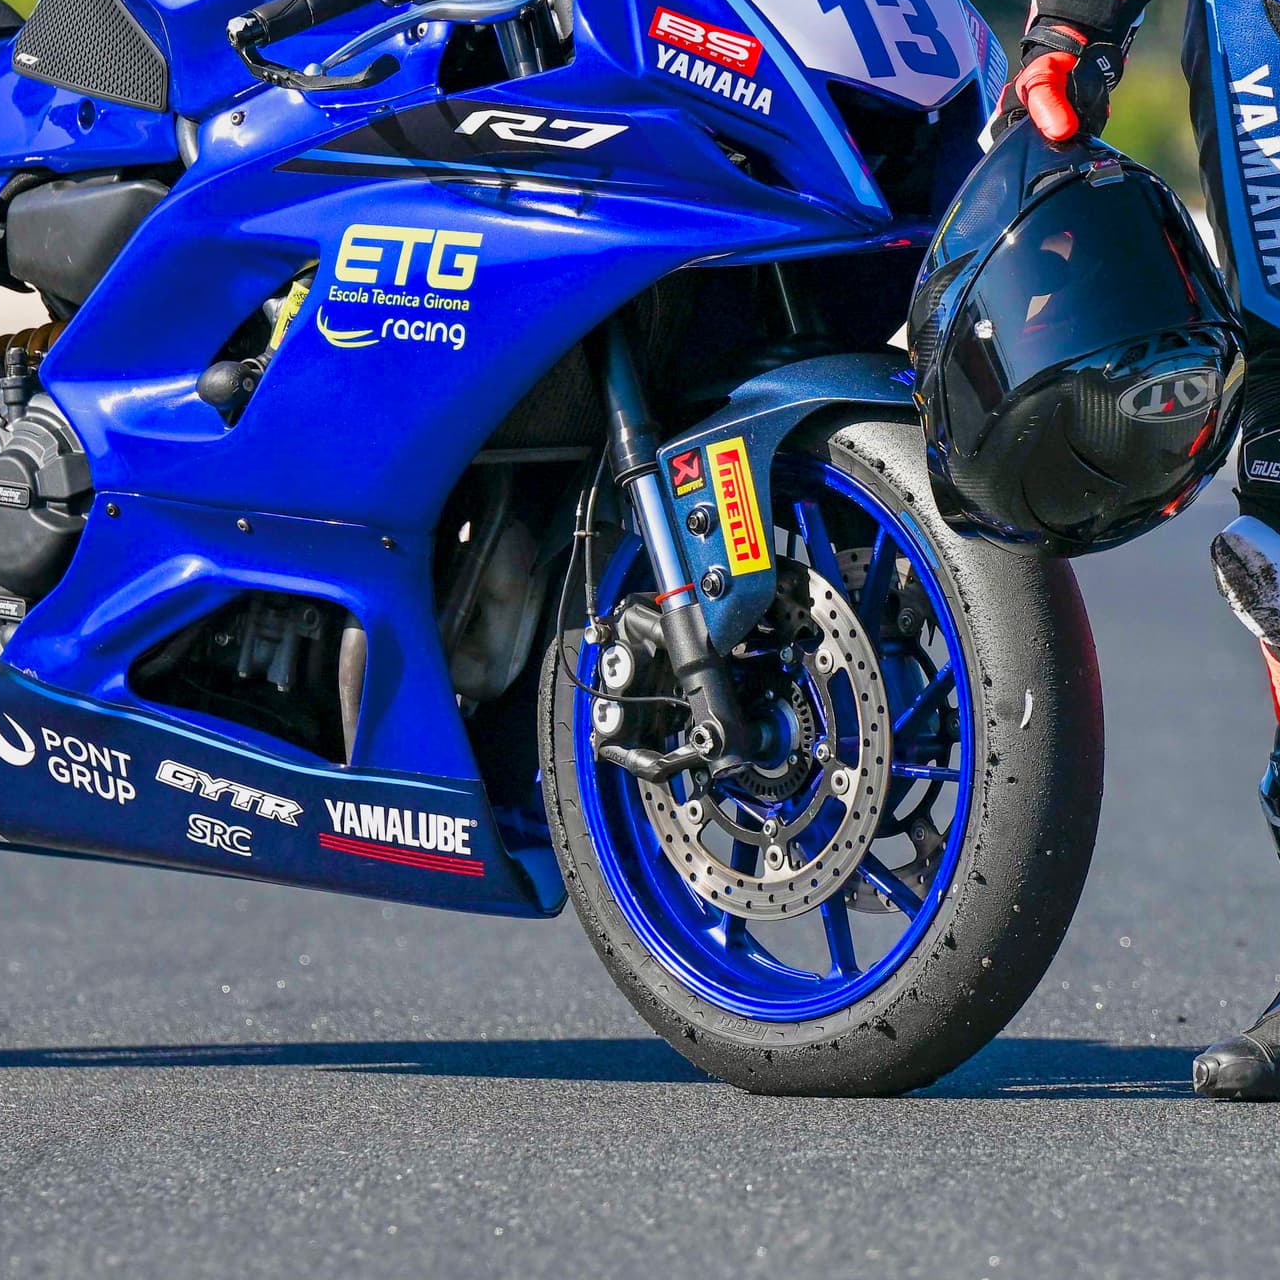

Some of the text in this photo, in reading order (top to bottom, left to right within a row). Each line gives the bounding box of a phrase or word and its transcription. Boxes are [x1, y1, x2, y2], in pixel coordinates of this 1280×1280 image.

[657, 12, 749, 61] BS
[656, 43, 773, 116] YAMAHA
[453, 109, 630, 150] R7
[334, 223, 484, 291] ETG
[328, 285, 369, 304] Escola
[423, 292, 470, 311] Girona
[381, 318, 466, 351] racing
[715, 448, 761, 562] PIRELLI
[41, 726, 132, 778] PONT
[47, 755, 137, 806] GRUP
[154, 759, 305, 828] GYTR
[186, 813, 253, 857] SRC
